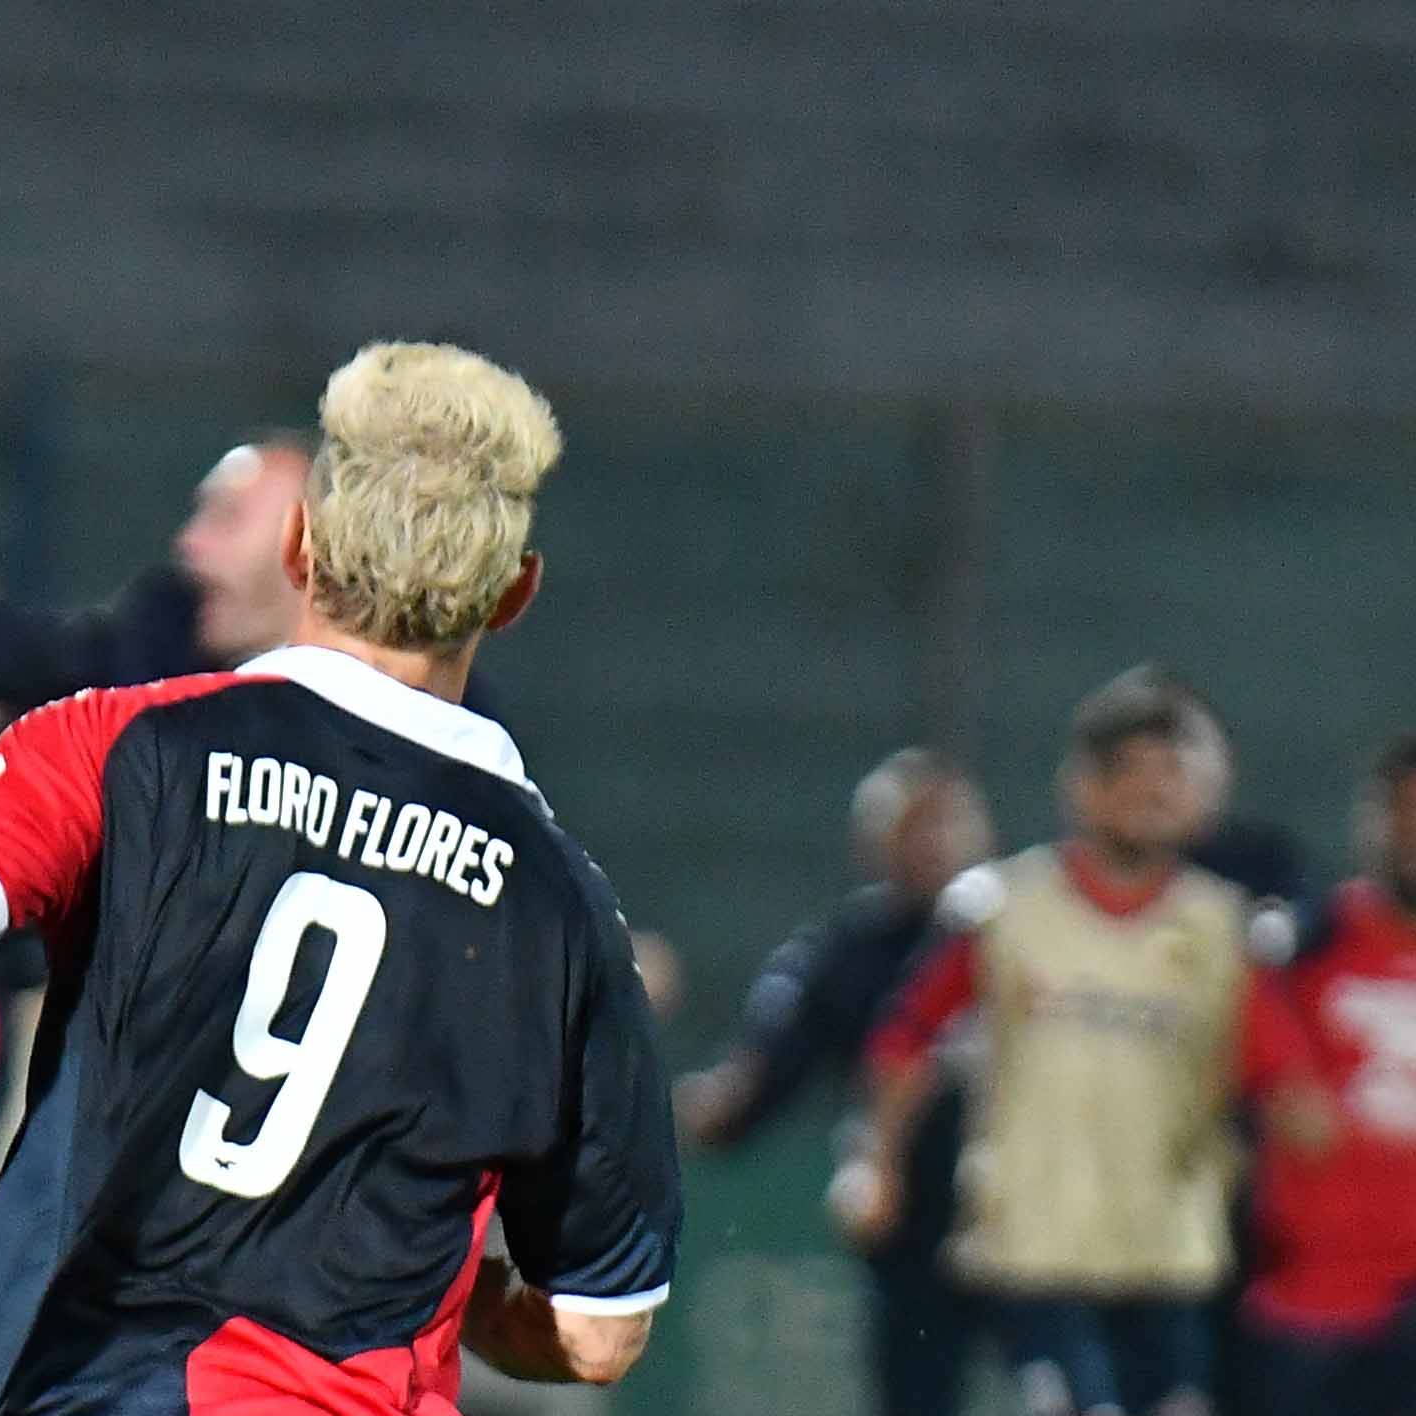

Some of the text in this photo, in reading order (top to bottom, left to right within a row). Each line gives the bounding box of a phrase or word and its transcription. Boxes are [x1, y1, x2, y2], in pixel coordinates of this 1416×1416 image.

[205, 752, 515, 907] FLORO FLORES
[178, 871, 387, 1198] 9
